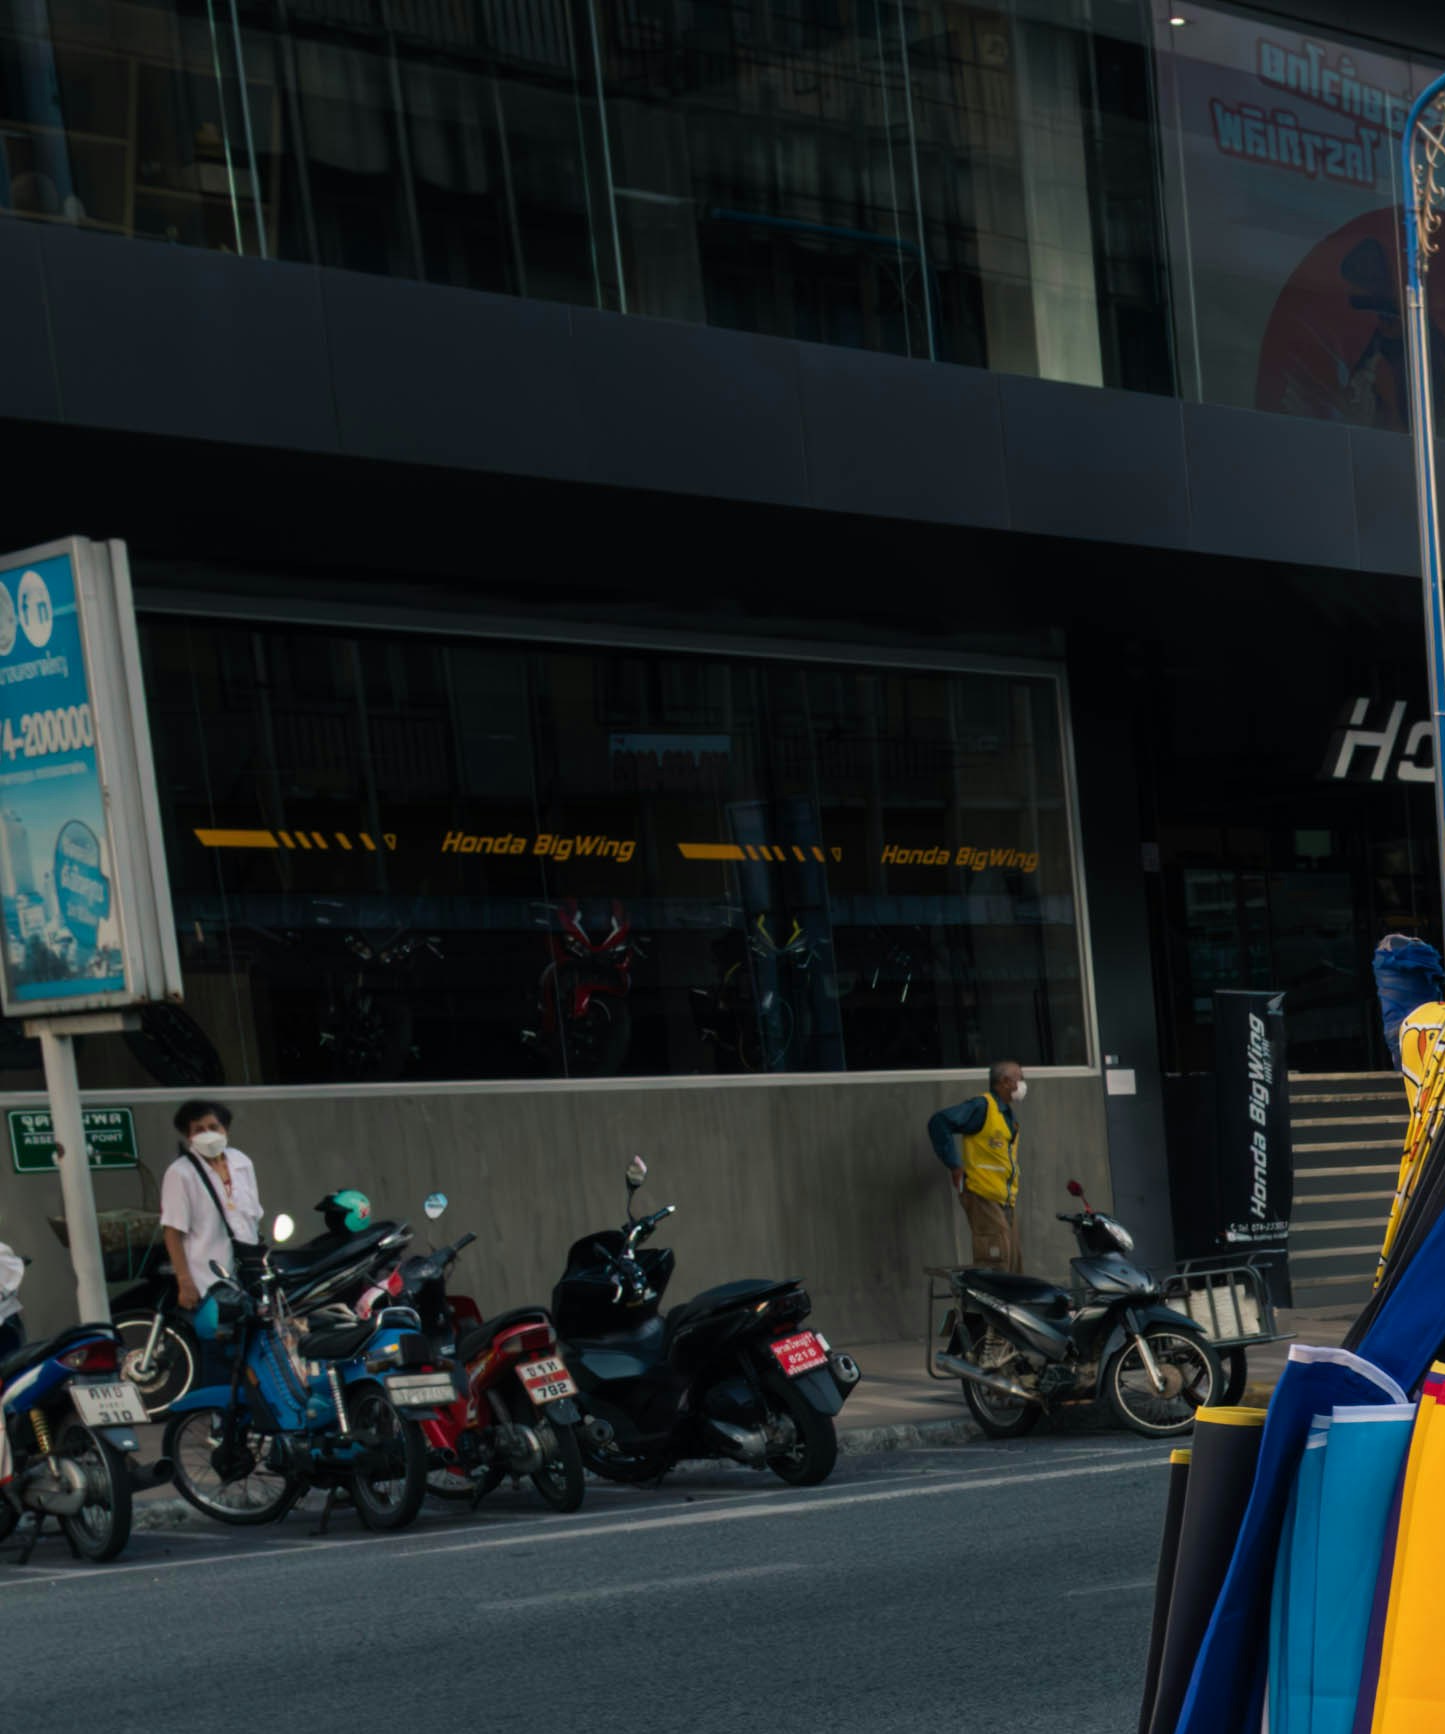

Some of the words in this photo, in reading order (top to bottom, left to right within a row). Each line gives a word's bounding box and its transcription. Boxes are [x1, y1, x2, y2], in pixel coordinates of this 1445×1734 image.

[441, 831, 528, 855] Honda
[533, 833, 637, 863] BigWing
[881, 844, 950, 865] Honda
[955, 847, 1040, 873] BigWing
[1247, 1011, 1270, 1127] BigWing
[91, 1132, 124, 1143] POINT
[1250, 1130, 1268, 1219] Honda
